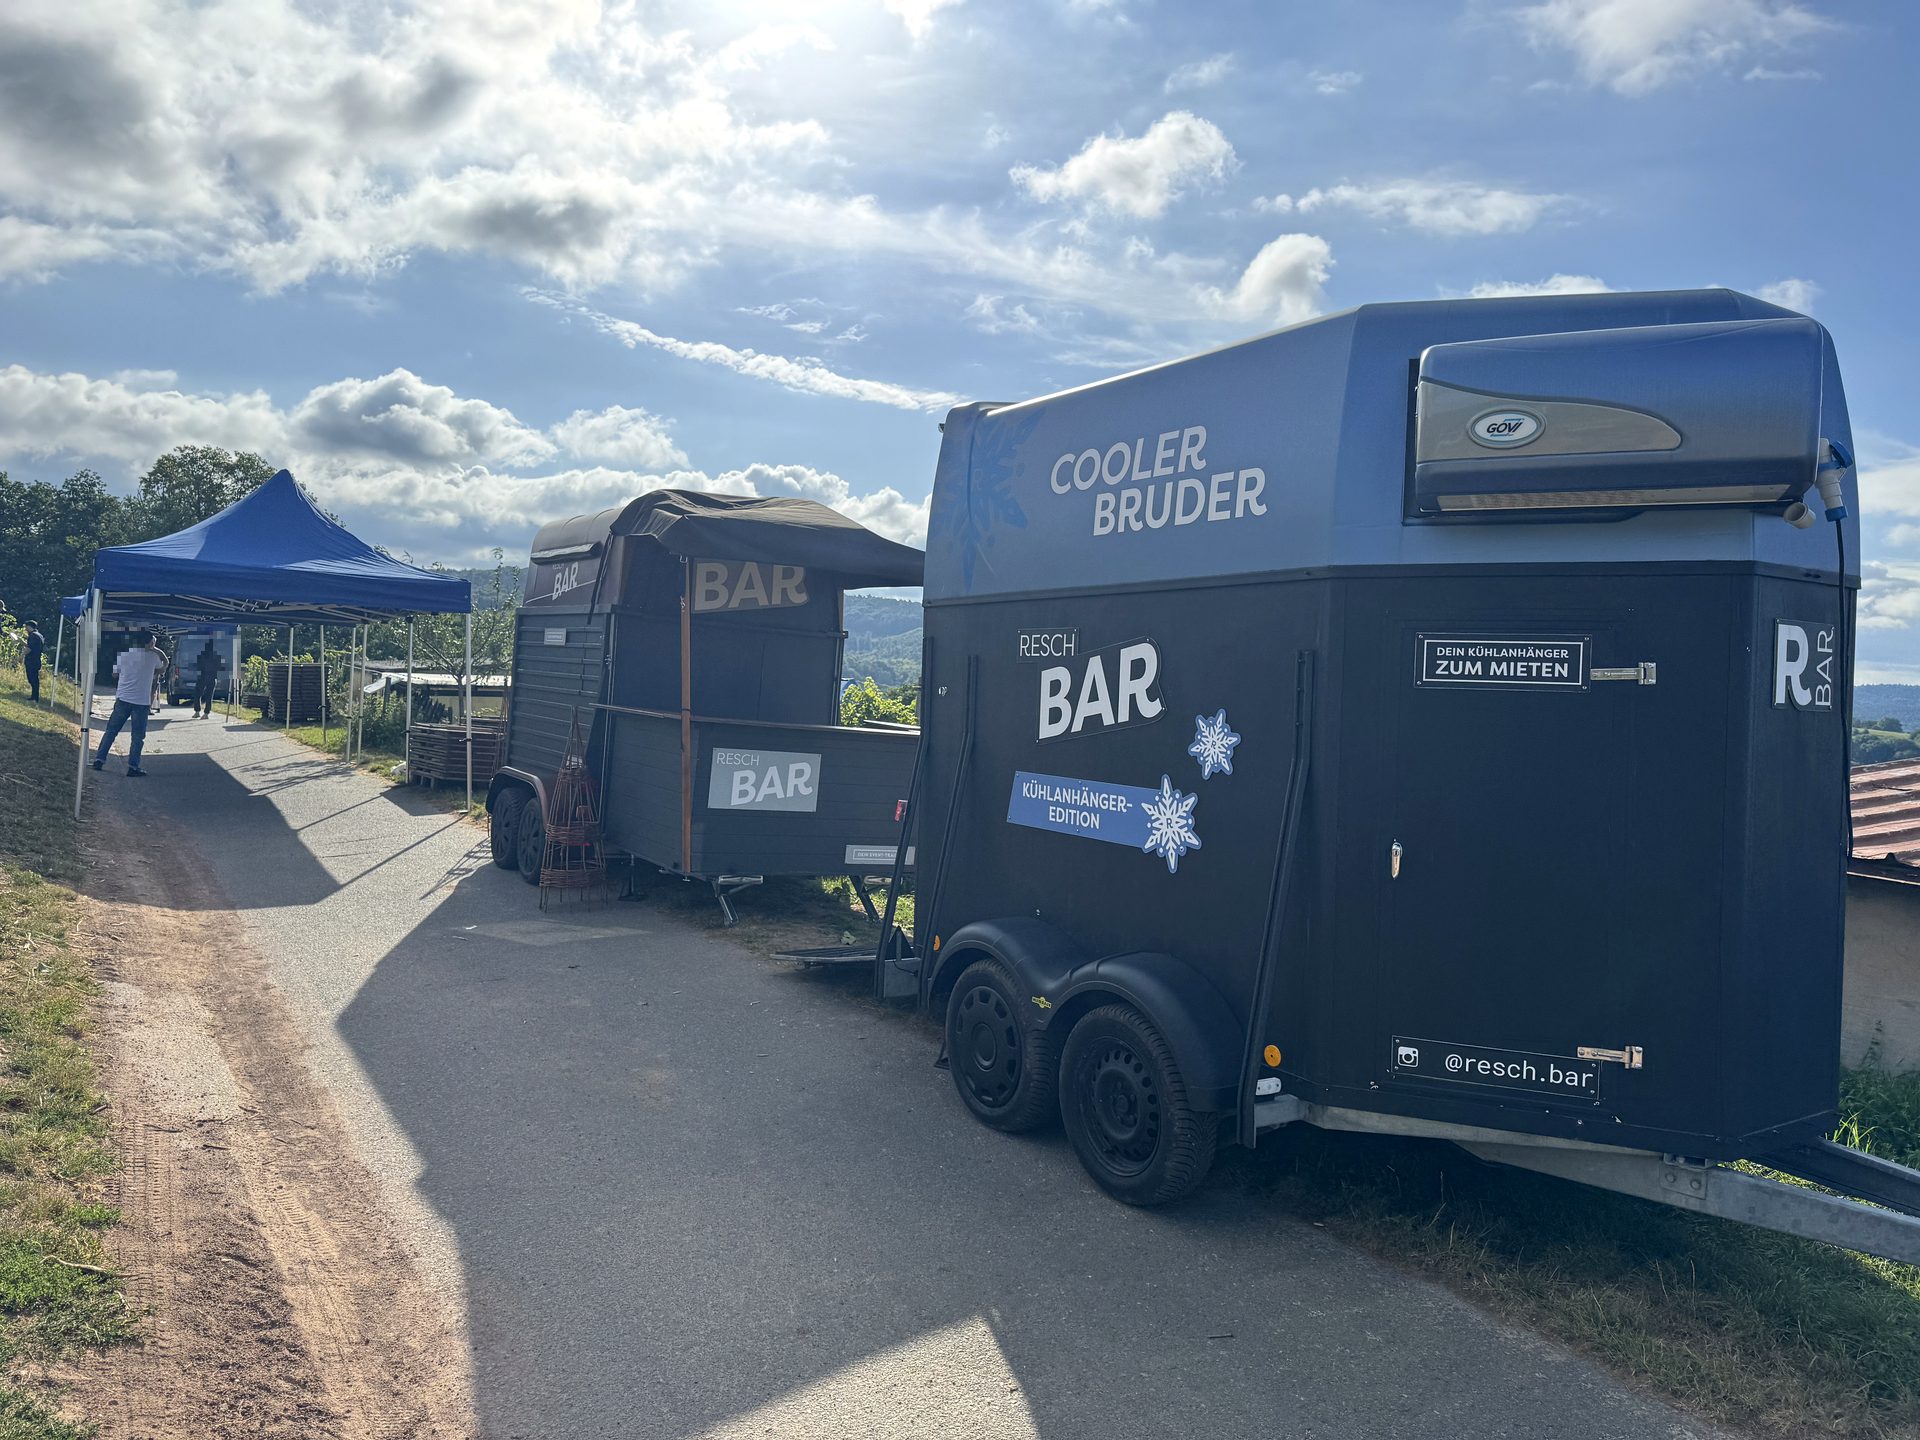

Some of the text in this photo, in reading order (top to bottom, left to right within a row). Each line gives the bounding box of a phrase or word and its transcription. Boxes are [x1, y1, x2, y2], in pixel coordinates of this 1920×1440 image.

[1487, 421, 1523, 434] GOVI
[1050, 425, 1207, 495] COOLER
[1093, 467, 1268, 537] BRUDER
[552, 561, 579, 601] BAR
[694, 561, 809, 611] BAR
[1019, 632, 1075, 657] RESCH
[1436, 645, 1569, 659] DEIN KÜHLANHÄNGER
[1435, 660, 1569, 678] ZUM MIETEN
[1775, 624, 1812, 706] R
[1815, 630, 1834, 706] BAR
[1038, 642, 1163, 740] BAR
[716, 752, 760, 766] RESCH
[730, 762, 813, 806] BAR
[1022, 779, 1133, 813] KÜHLANHÄNGER-
[1048, 806, 1100, 830] EDITION
[1444, 1053, 1594, 1088] @resch.bar
